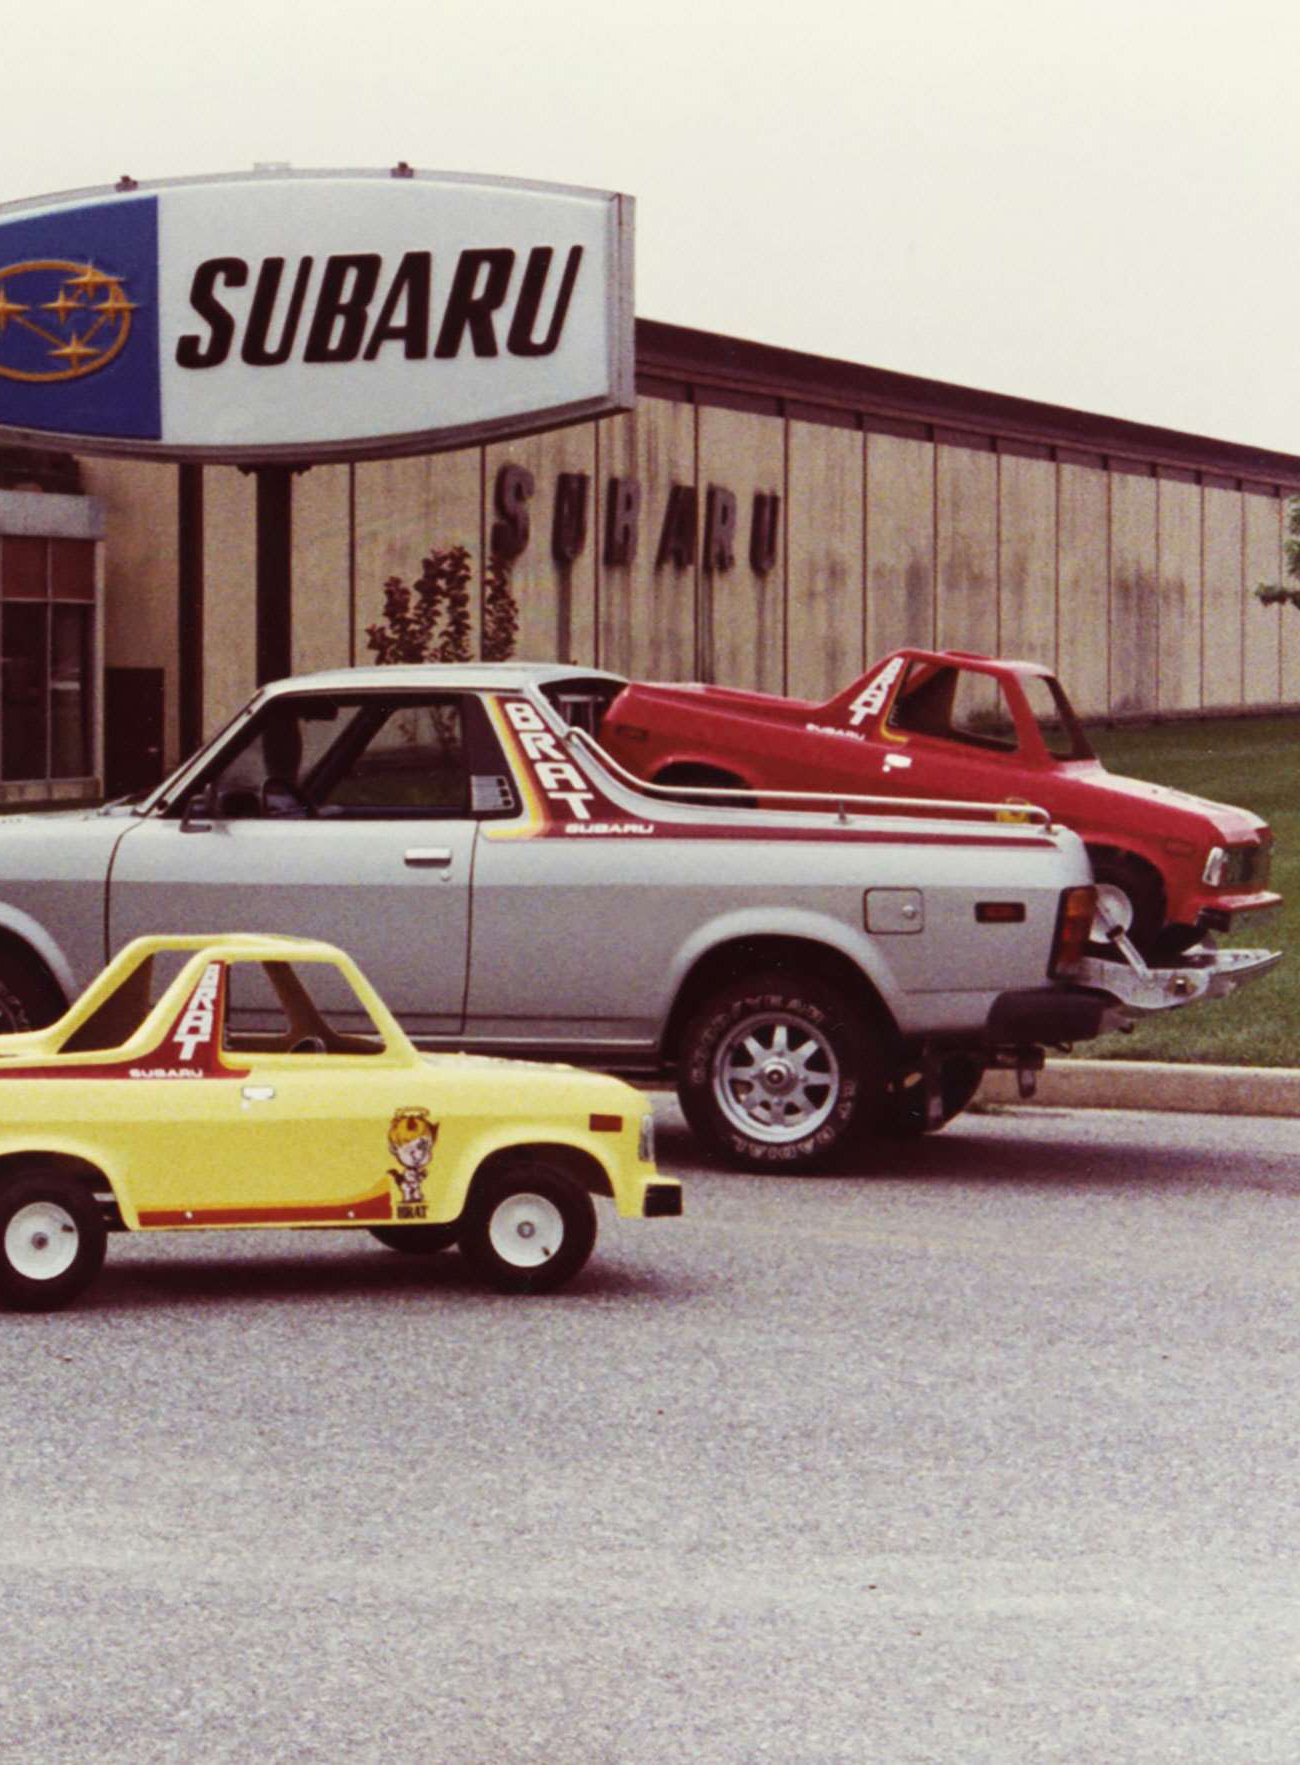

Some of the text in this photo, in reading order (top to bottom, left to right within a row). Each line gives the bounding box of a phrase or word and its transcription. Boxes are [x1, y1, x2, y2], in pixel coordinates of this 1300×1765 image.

[175, 245, 584, 370] SUBARU
[490, 463, 781, 576] SUBARU
[847, 656, 905, 726] BRAT
[504, 702, 595, 820] BRAT
[564, 822, 655, 834] SUBARU
[172, 963, 221, 1061] BRAT
[129, 1068, 204, 1079] SUBARU
